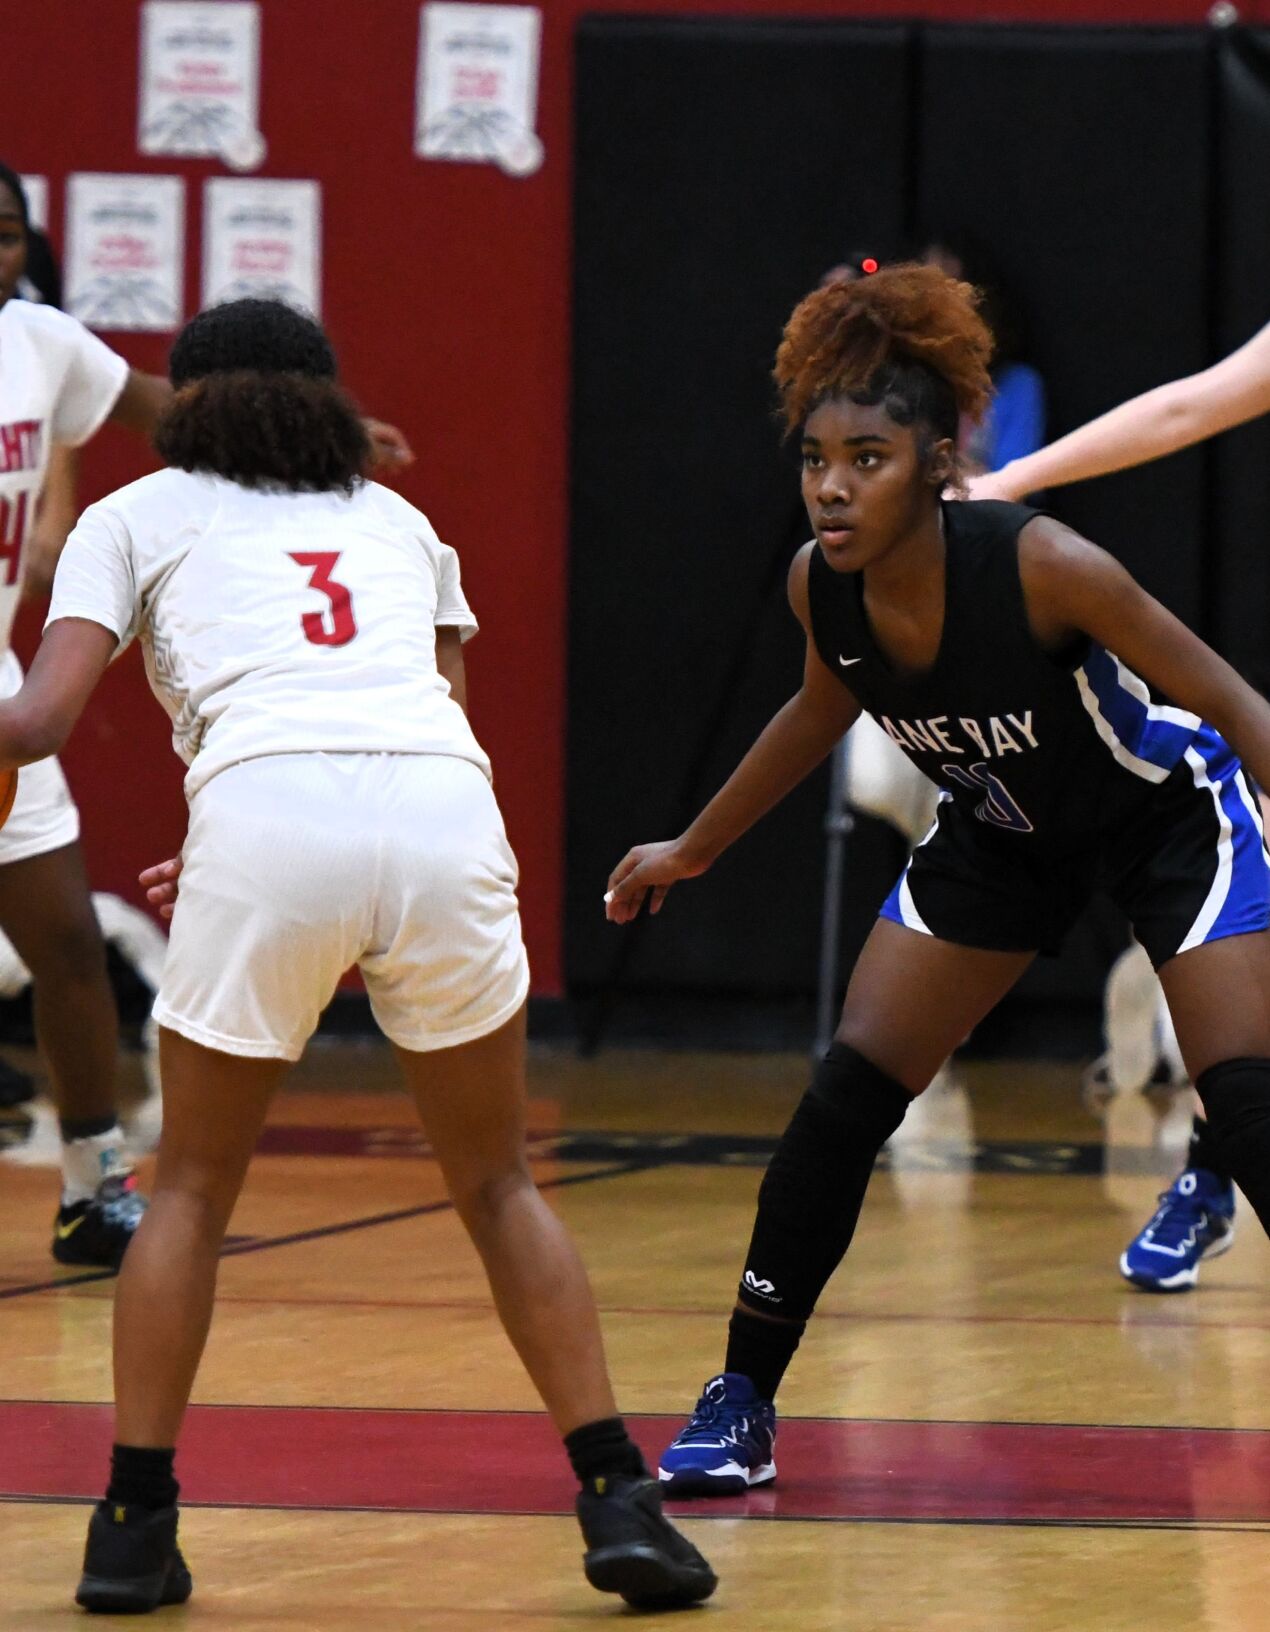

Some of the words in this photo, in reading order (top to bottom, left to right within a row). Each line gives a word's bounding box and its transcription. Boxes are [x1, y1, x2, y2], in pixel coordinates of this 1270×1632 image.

[0, 419, 42, 473] HT
[283, 549, 357, 648] 3
[880, 715, 964, 754] ANE
